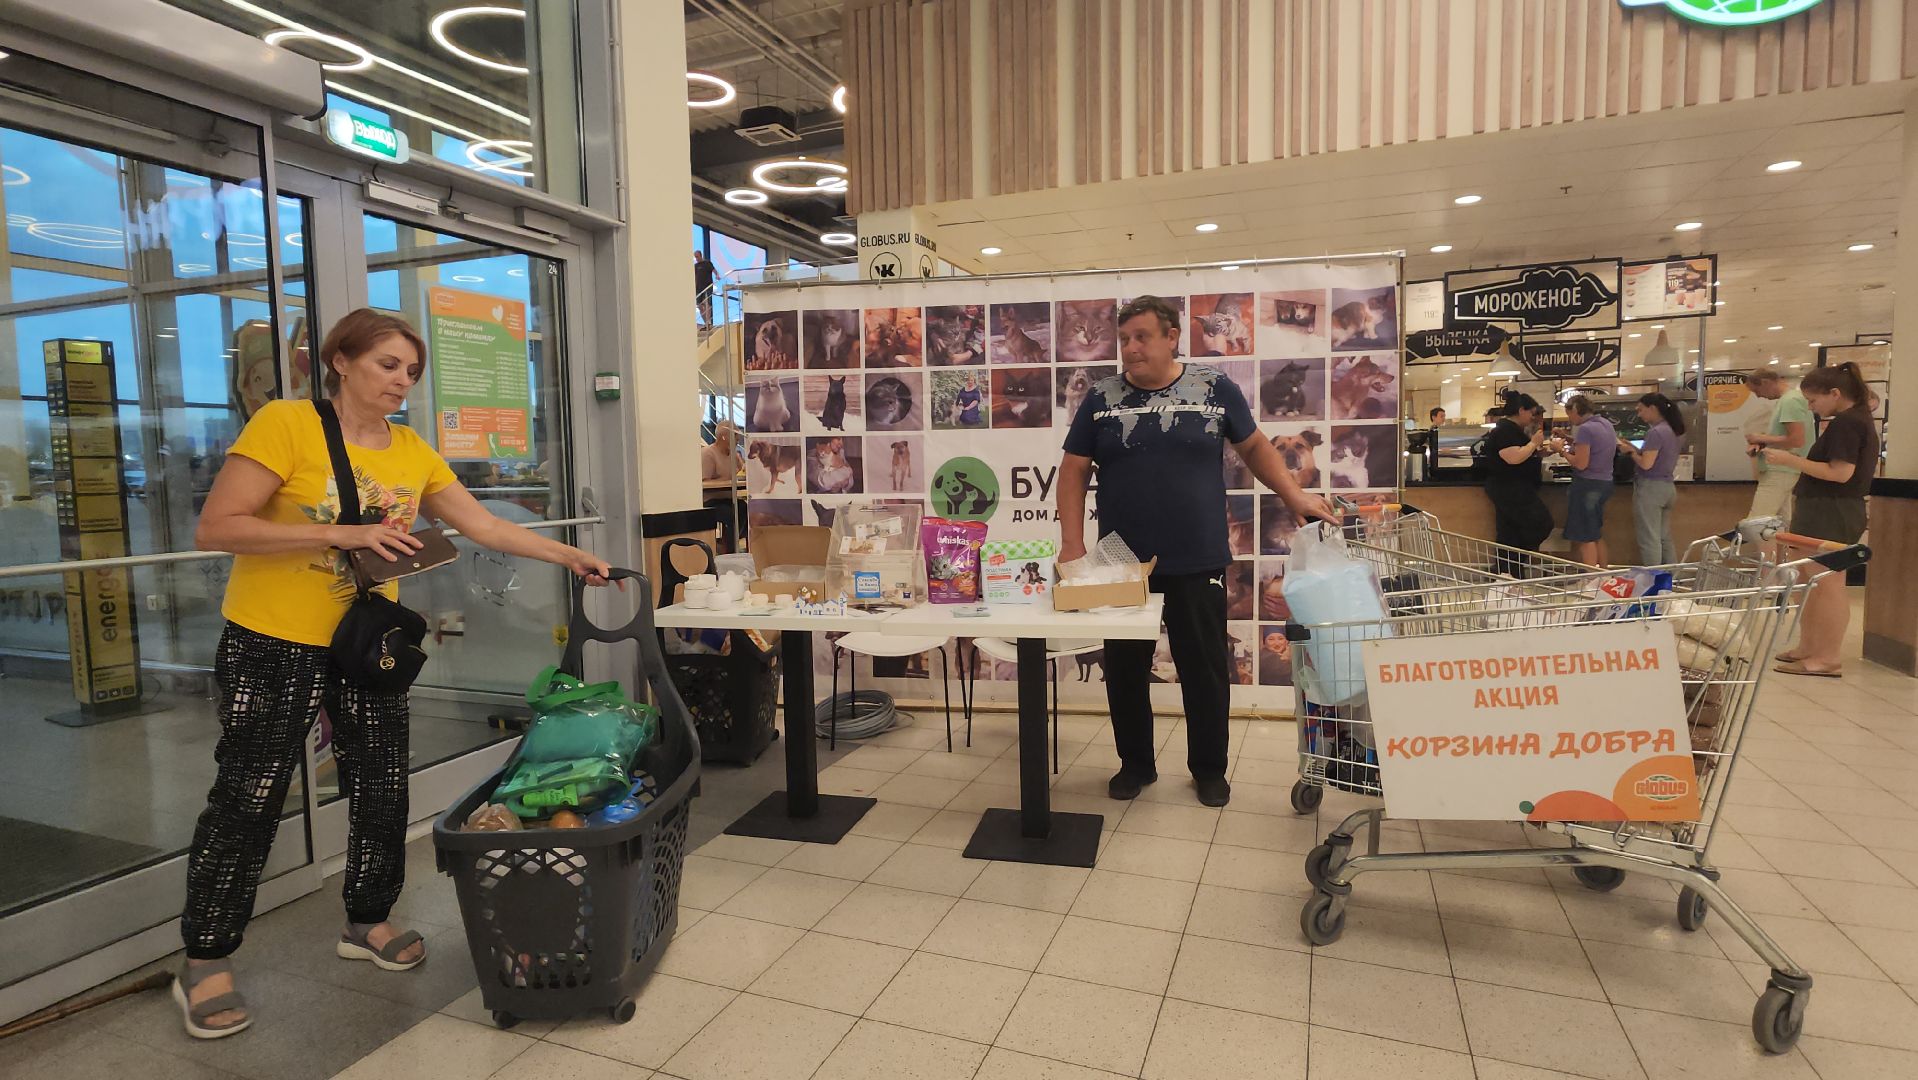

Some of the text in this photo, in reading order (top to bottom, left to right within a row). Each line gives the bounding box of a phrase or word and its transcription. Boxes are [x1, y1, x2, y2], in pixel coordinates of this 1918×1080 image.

[353, 120, 397, 150] ВЫХОД
[860, 232, 911, 248] GLOBUS.RU
[914, 233, 937, 253] GLOBUS.RU
[548, 263, 558, 275] 24
[1474, 286, 1582, 314] МОРОЖЕНОЕ
[1425, 329, 1490, 348] ВЫПЕЧКА
[1535, 351, 1585, 366] НАПИТКИ
[1704, 375, 1738, 386] ГОРЯЧИЕ
[1012, 510, 1048, 523] ДОМ
[937, 535, 970, 546] whiskas
[1379, 648, 1660, 684] БЛАГОТВОРИТЕЛЬНАЯ
[1473, 685, 1559, 710] АКЦИЯ
[1387, 729, 1676, 760] КОРЗИНА ДОБРА
